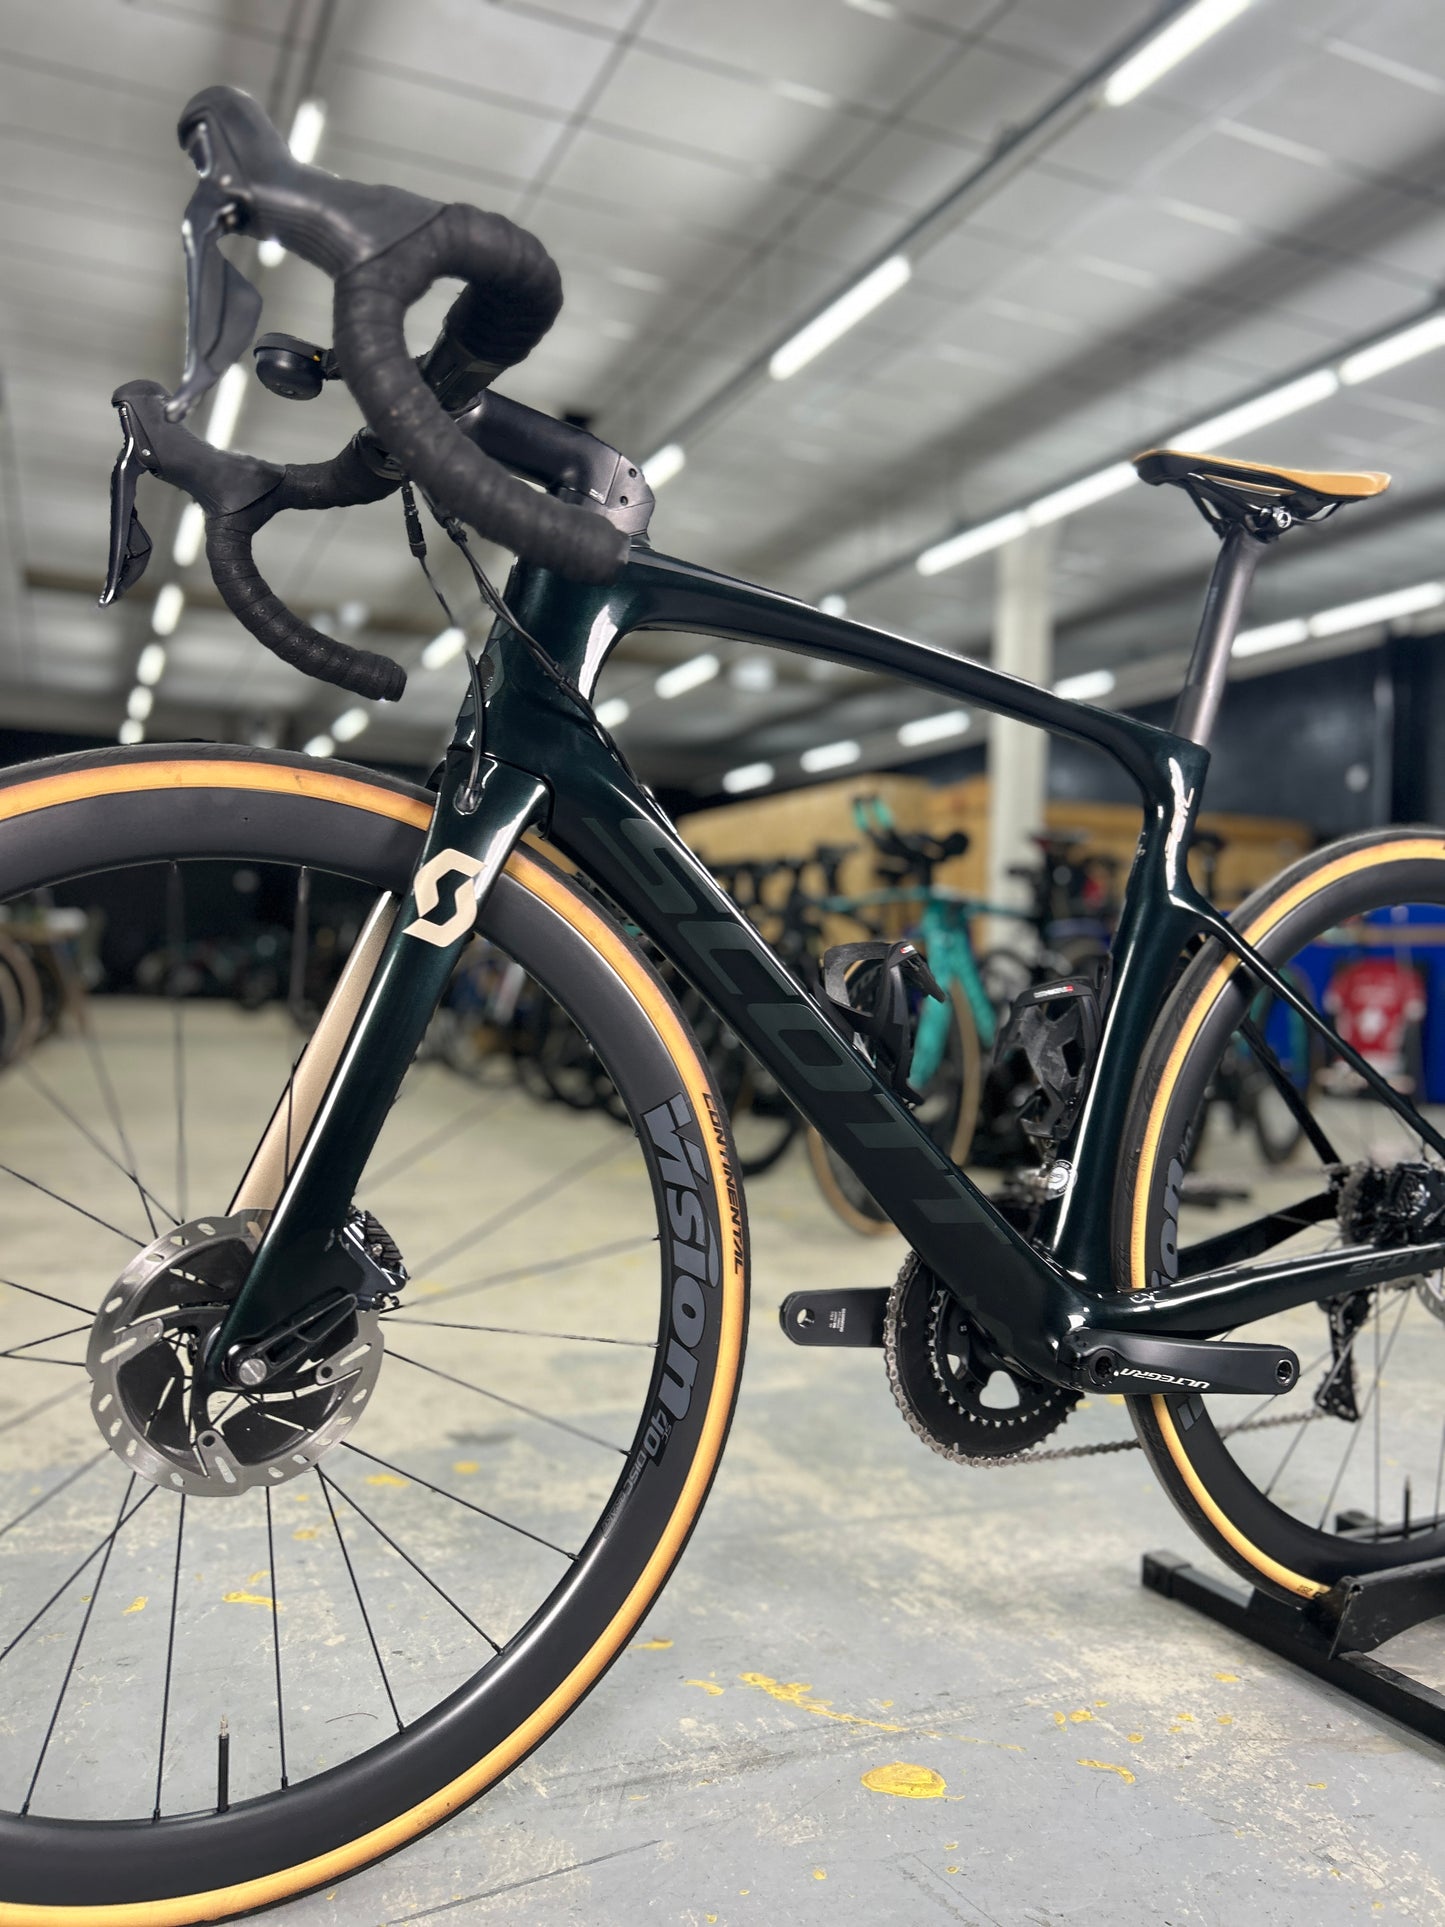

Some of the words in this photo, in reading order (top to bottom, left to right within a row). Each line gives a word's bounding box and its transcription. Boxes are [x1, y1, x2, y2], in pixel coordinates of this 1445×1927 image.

[583, 817, 1013, 1245] SCOTT
[702, 1092, 743, 1275] CONTINENTAL
[643, 1093, 720, 1420] Vision
[643, 1408, 667, 1457] 40
[1120, 1368, 1210, 1389] ULTEGRA
[622, 1449, 647, 1496] DISC
